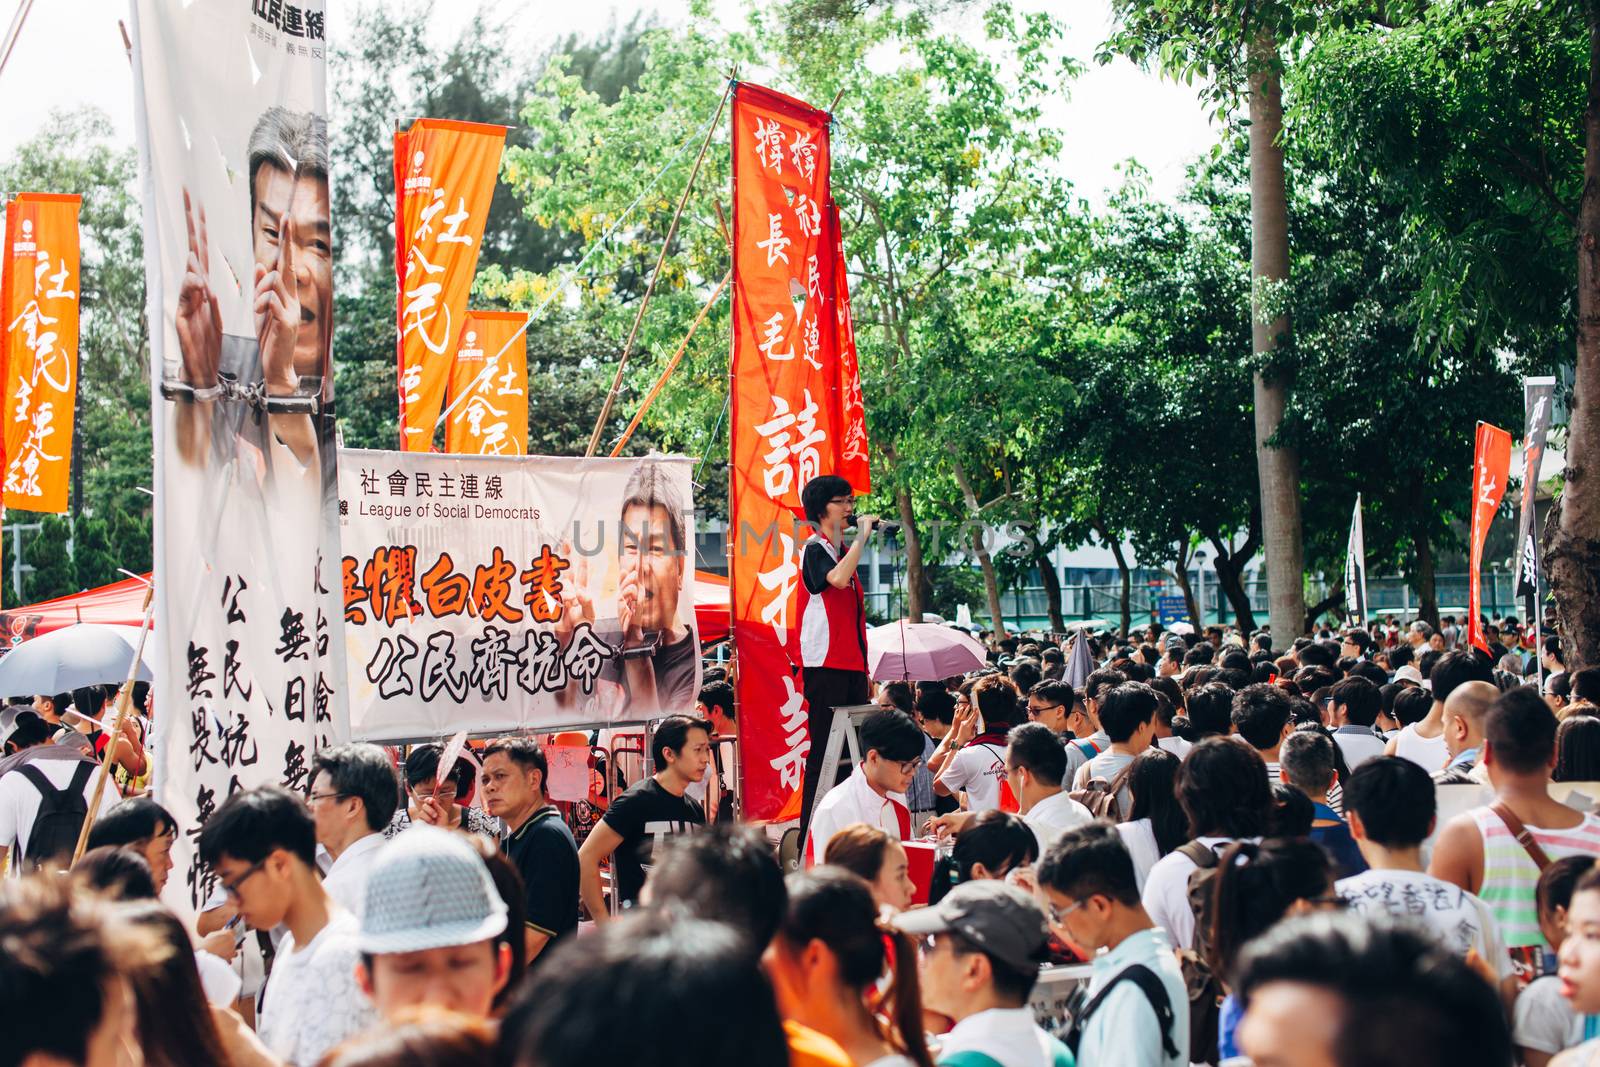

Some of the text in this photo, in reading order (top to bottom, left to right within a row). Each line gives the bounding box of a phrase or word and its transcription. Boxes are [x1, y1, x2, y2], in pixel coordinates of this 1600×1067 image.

[360, 468, 504, 500] 社會民主連線
[359, 501, 541, 520] League of Social Democrats
[366, 622, 613, 704] 公民齊抗命
